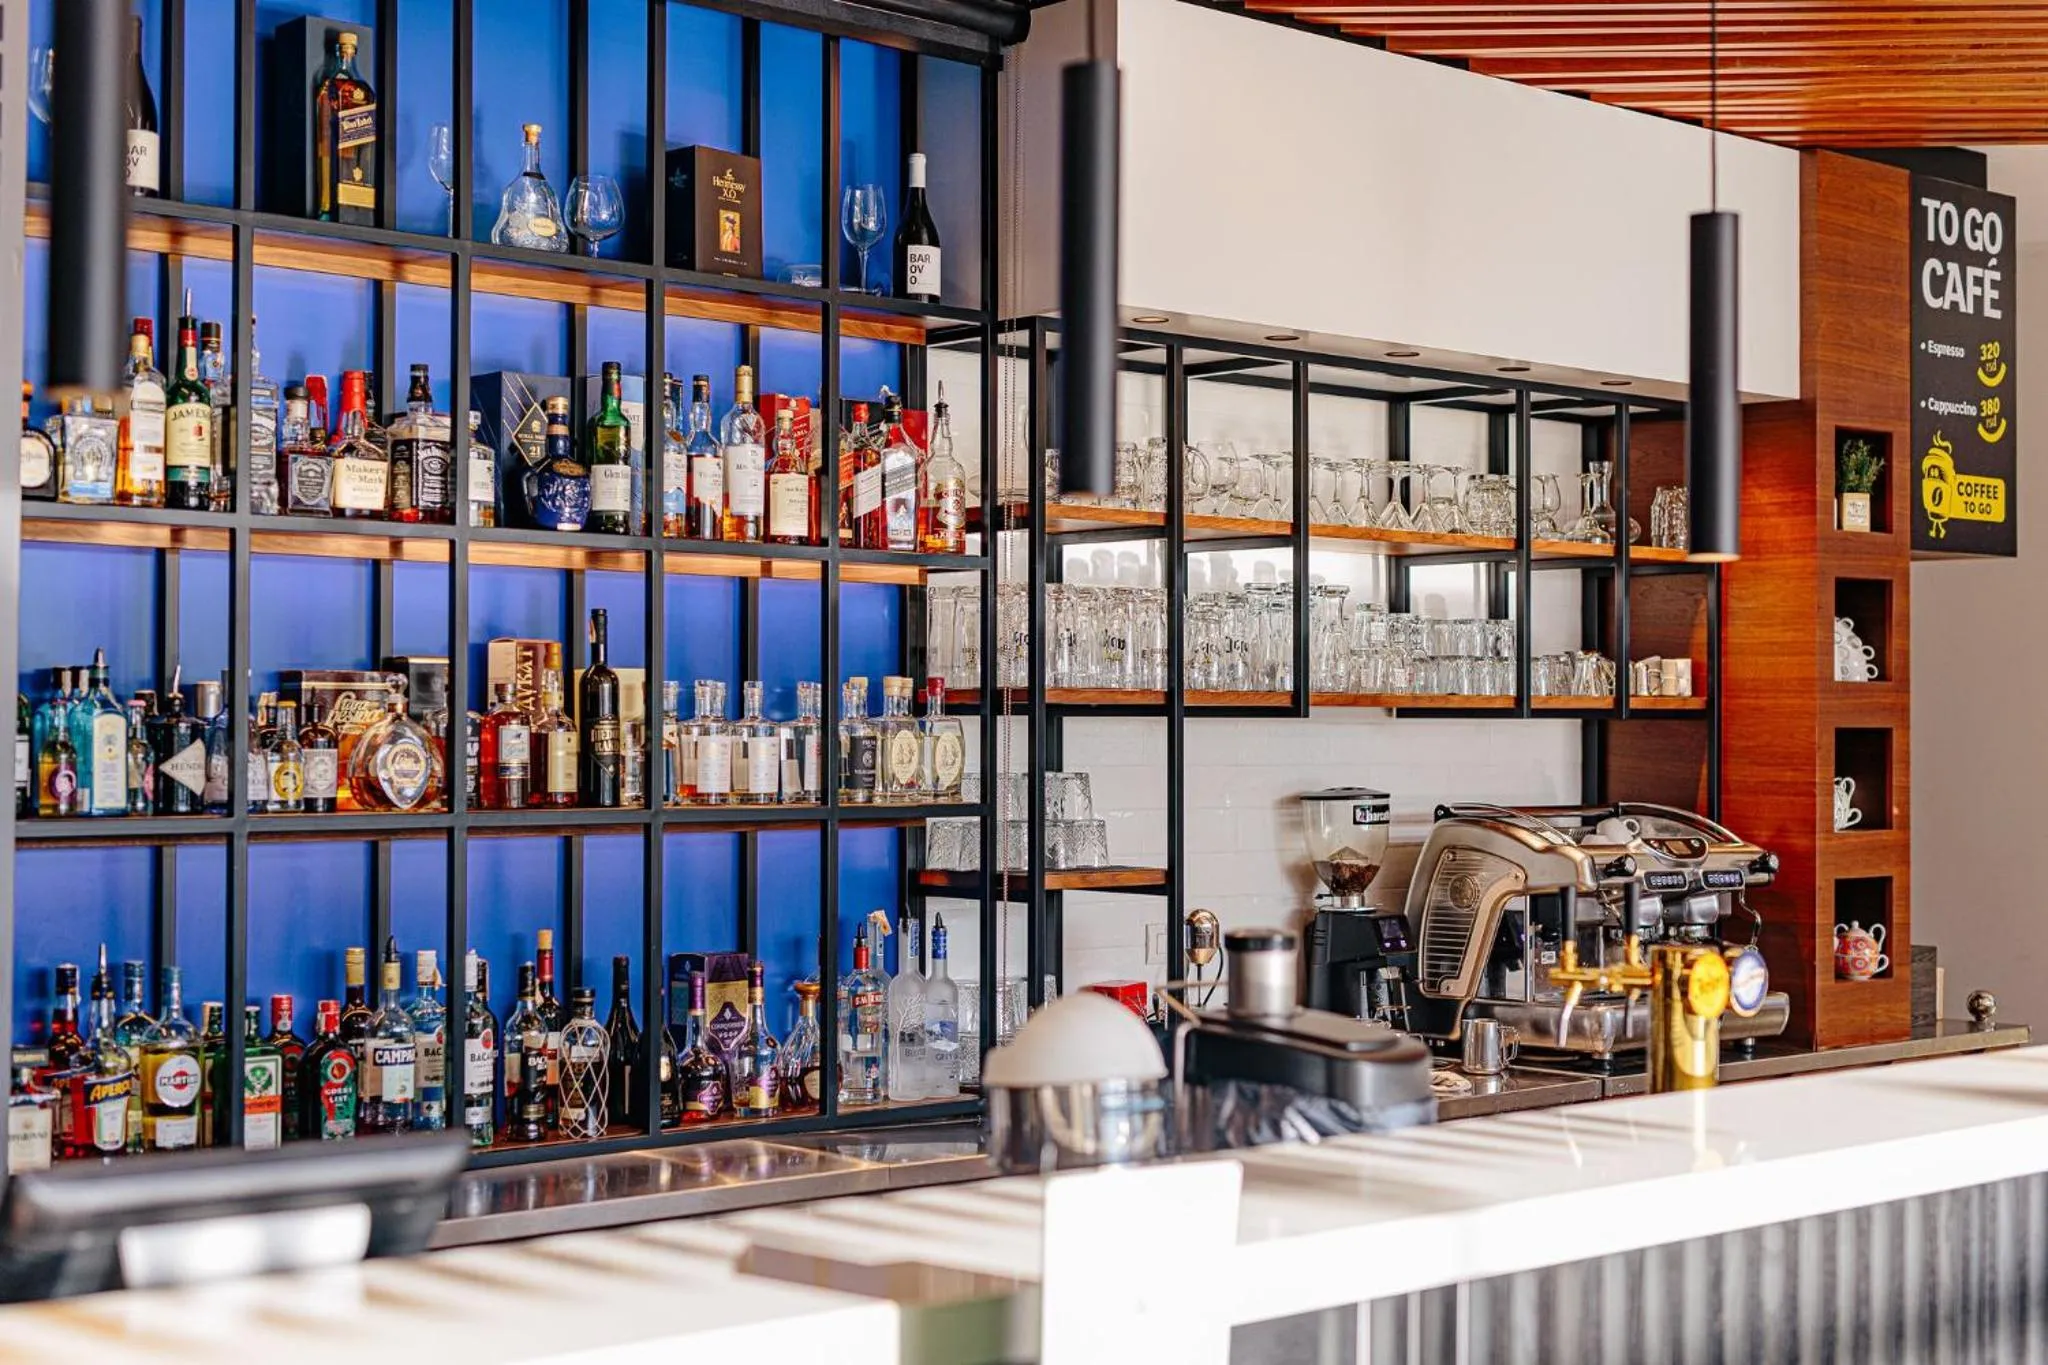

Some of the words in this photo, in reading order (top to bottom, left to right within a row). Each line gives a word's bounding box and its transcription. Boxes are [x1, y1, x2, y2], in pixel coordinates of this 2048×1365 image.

[1921, 196, 1959, 246] TO
[1964, 207, 2003, 255] GO
[1922, 257, 2002, 320] CAFÉ
[1928, 340, 1965, 358] Espresso
[1980, 341, 2000, 361] 320
[1928, 397, 1977, 416] Cappuccino
[1980, 396, 2000, 417] 380
[1957, 481, 1999, 500] COFFEE
[1964, 501, 1976, 513] TO
[1978, 503, 1992, 515] GO
